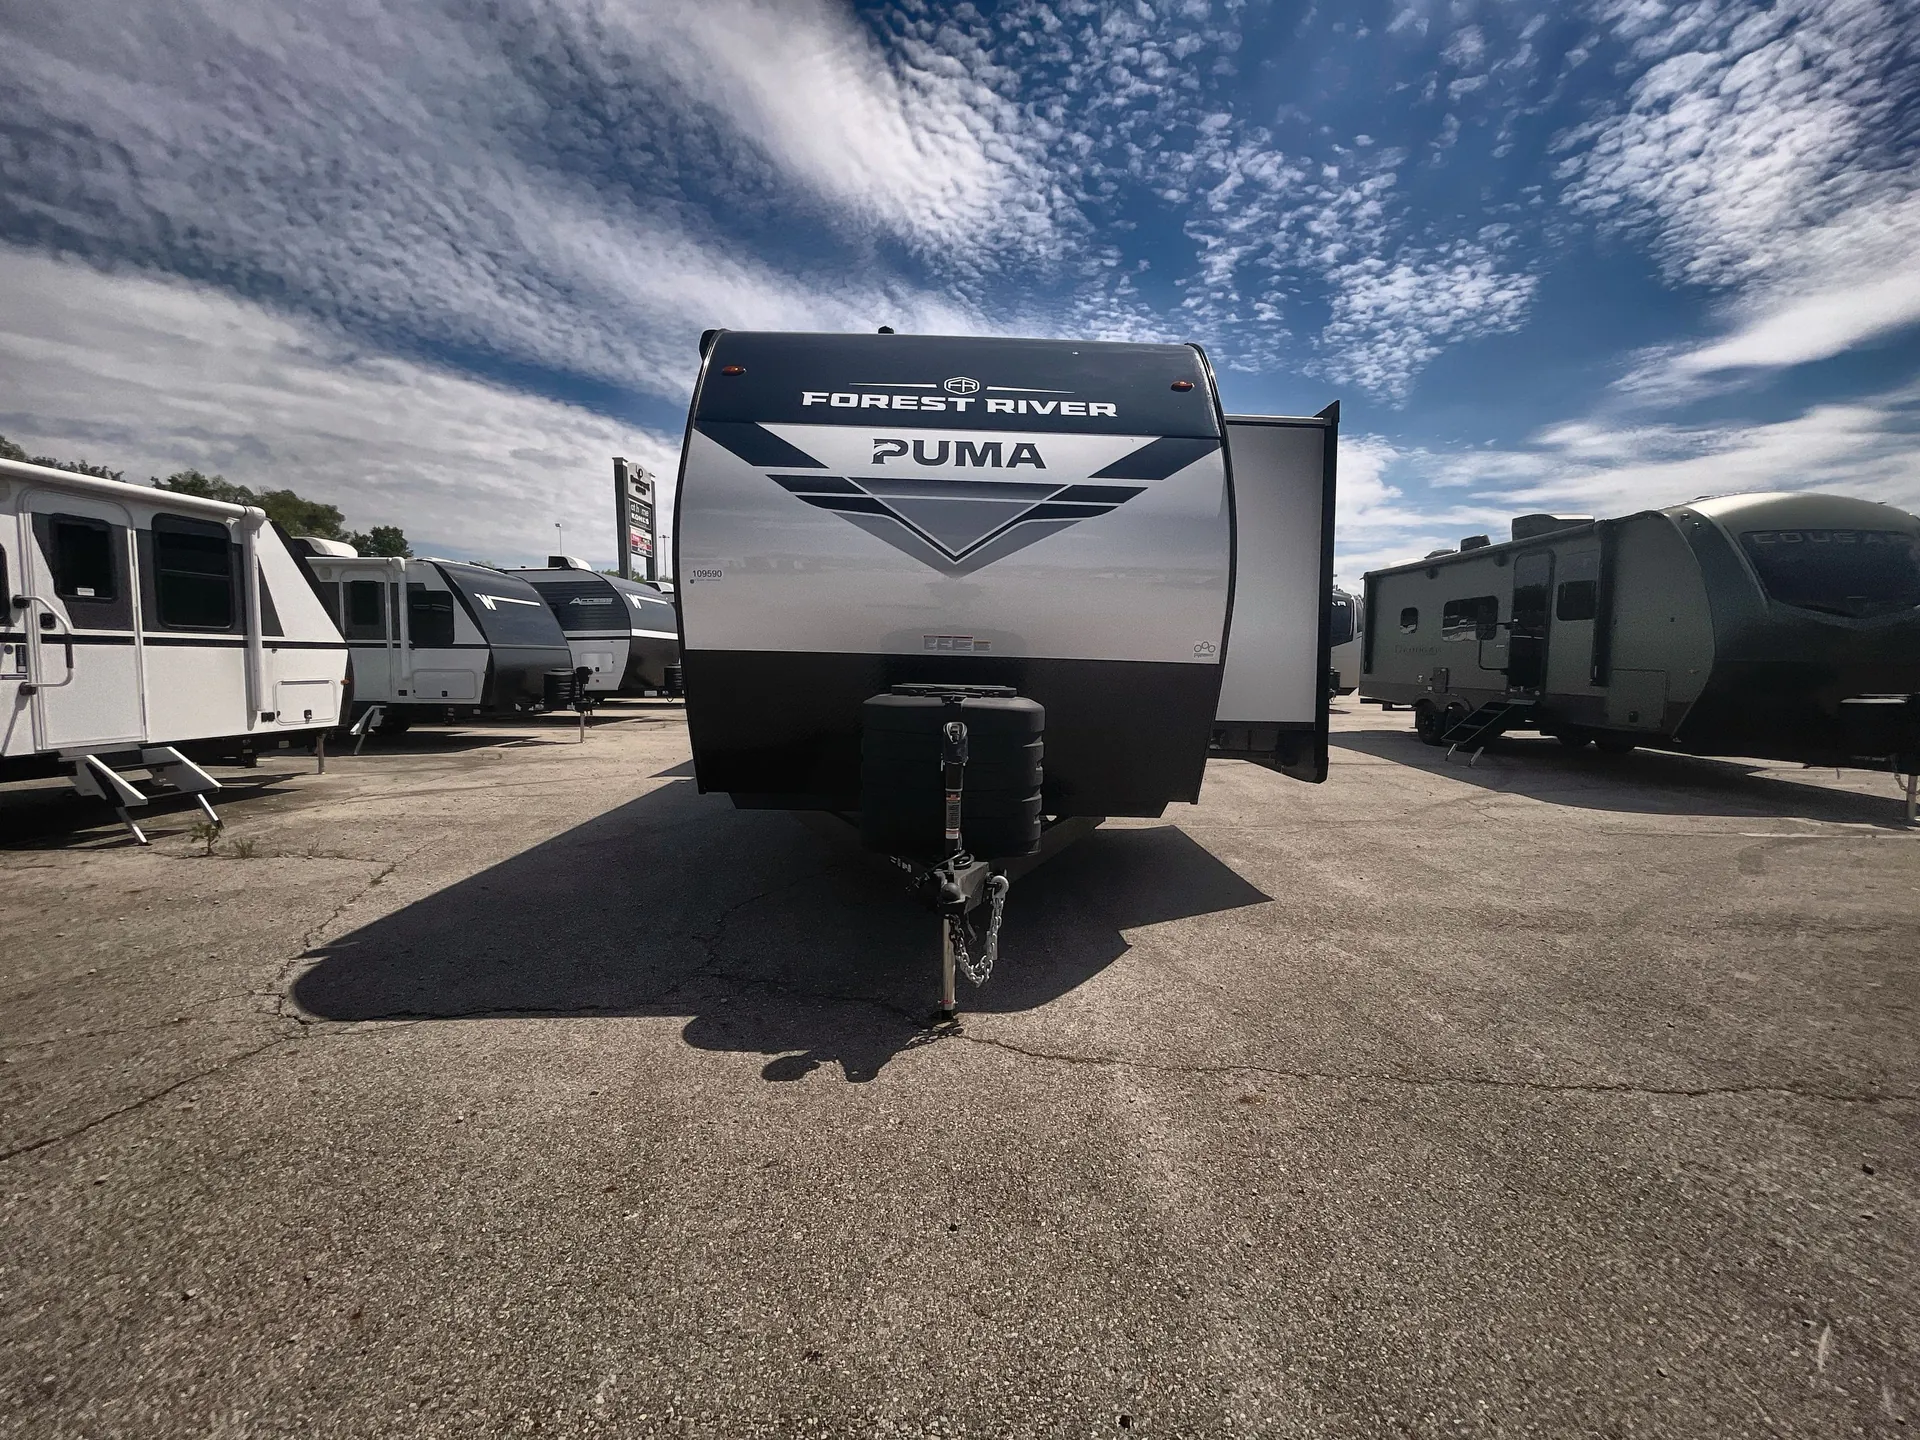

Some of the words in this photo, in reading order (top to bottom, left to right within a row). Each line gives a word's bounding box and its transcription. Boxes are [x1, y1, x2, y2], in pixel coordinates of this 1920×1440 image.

[945, 378, 978, 394] FR
[802, 391, 975, 412] FOREST
[985, 398, 1118, 417] RIVER
[871, 438, 1047, 469] PUMA
[692, 569, 722, 578] 109590
